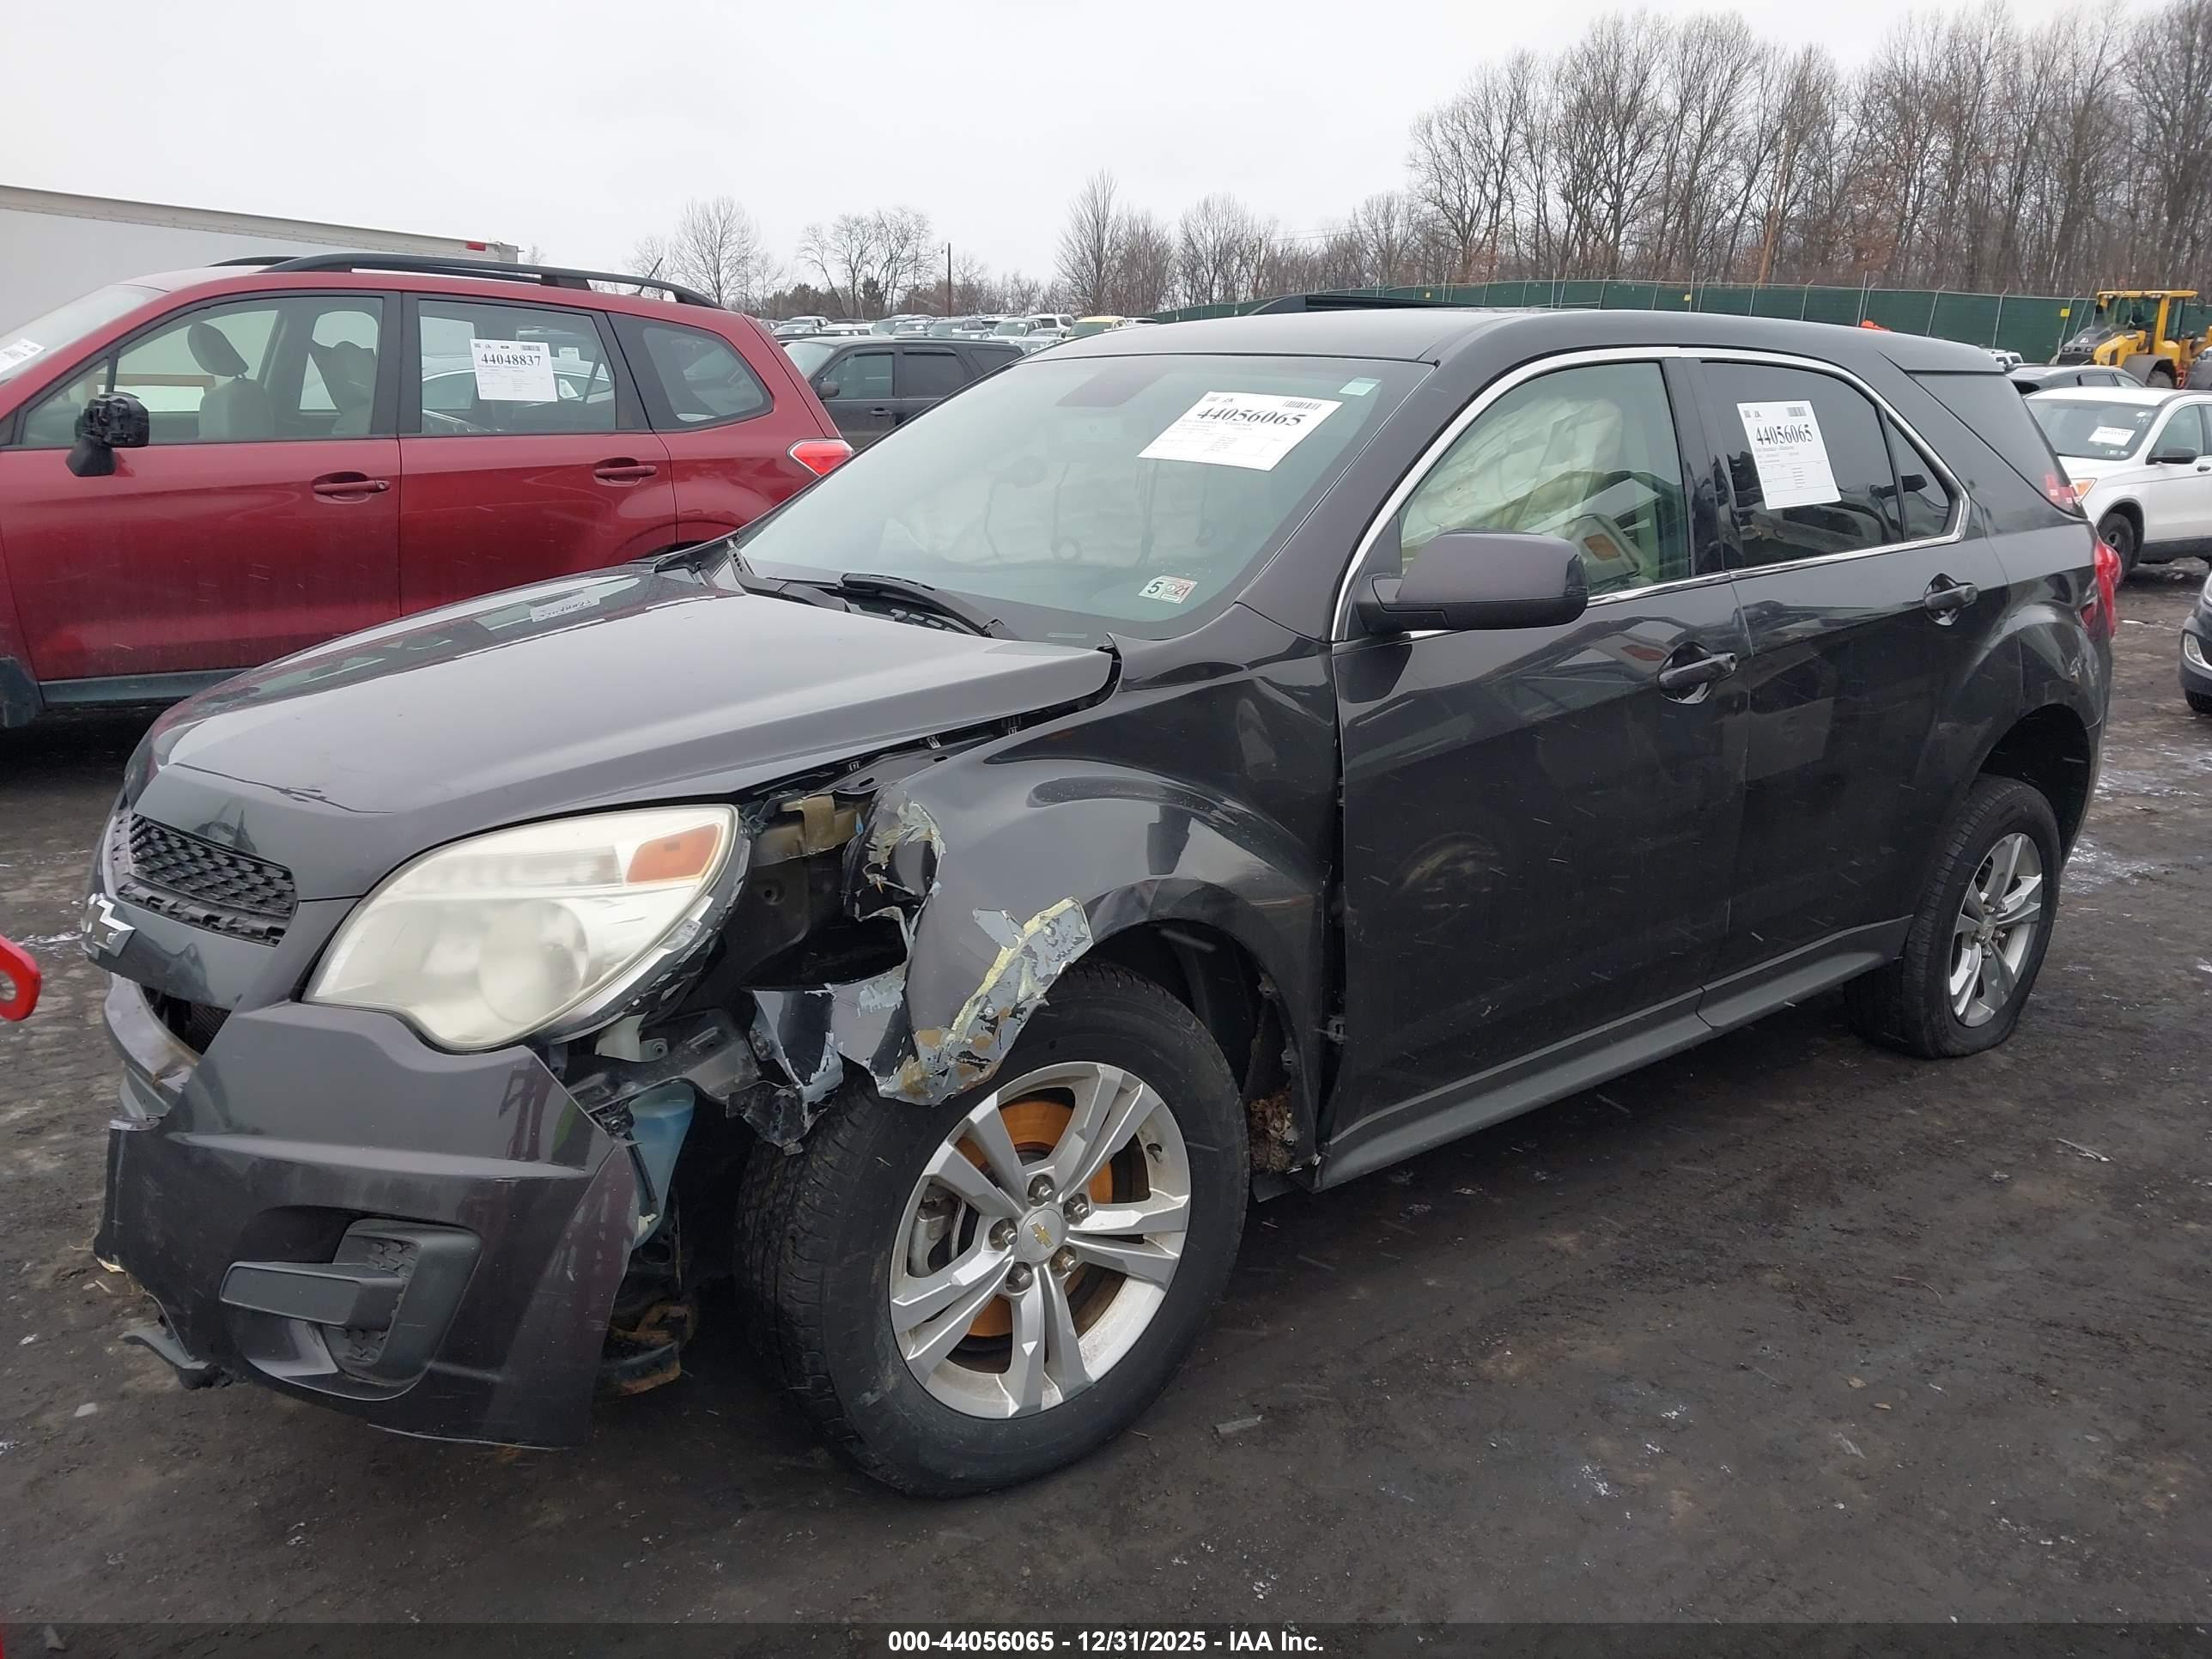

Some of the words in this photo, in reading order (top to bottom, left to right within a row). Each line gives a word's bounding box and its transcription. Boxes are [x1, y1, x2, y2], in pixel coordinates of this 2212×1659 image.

[481, 352, 541, 367] 44048837
[1197, 407, 1307, 427] 44056065
[1756, 423, 1814, 445] 44056065
[1147, 580, 1164, 594] 5
